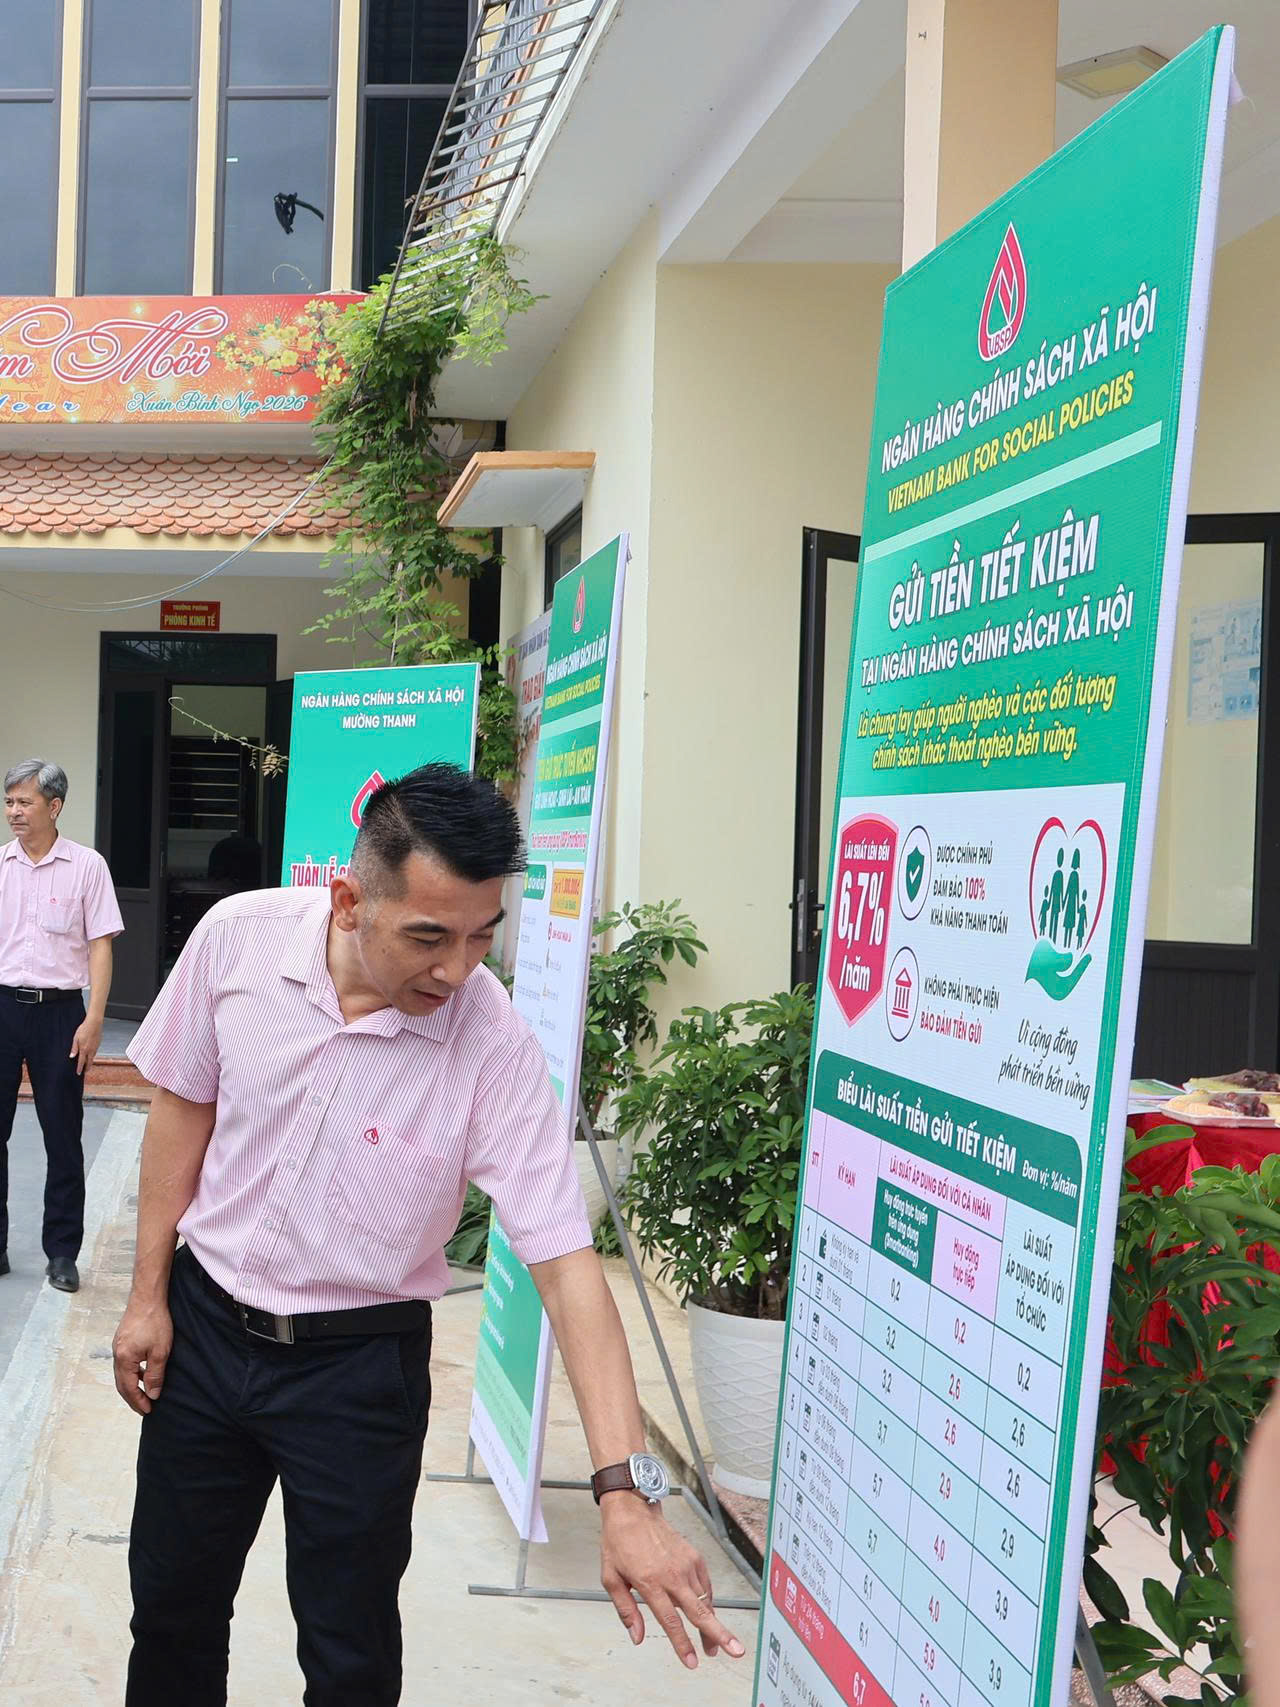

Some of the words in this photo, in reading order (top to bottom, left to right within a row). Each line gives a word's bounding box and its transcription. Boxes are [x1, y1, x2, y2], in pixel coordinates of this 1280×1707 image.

[51, 303, 229, 385] Mới
[881, 419, 921, 474] NGÂN
[922, 400, 965, 453] HÀNG
[968, 364, 1023, 429] CHÍNH
[1024, 333, 1076, 400] SÁCH
[1078, 304, 1110, 373] XÃ
[1114, 280, 1157, 354] HỘI
[176, 390, 221, 413] Bính
[261, 395, 308, 413] 2026
[888, 468, 934, 514] VIETNAM
[936, 452, 971, 494] BANK
[972, 437, 998, 476] FOR
[1001, 409, 1055, 463] SOCIAL
[1059, 370, 1134, 436] POLICIES
[888, 560, 924, 630] GỬI
[929, 538, 975, 619] TIỀN
[980, 519, 1027, 604] TIẾT
[1030, 507, 1100, 598] KIỆM
[862, 656, 879, 695] TẠI
[880, 641, 917, 684] NGÂN
[918, 633, 959, 675] HÀNG
[961, 619, 1010, 666] CHÍNH
[1013, 607, 1061, 655] SÁCH
[1063, 590, 1091, 643] XÃ
[1095, 583, 1134, 643] HỘI
[301, 693, 330, 708] NGÂN
[331, 691, 360, 708] HÀNG
[362, 688, 394, 706] CHÍNH
[396, 688, 425, 705] SÁCH
[427, 687, 442, 704] XÃ
[445, 685, 465, 708] HỘI
[869, 707, 896, 741] chung
[897, 704, 913, 737] tay
[913, 697, 935, 737] giúp
[936, 693, 967, 734] người
[967, 687, 1003, 731] nghèo
[1005, 683, 1021, 717] và
[1023, 679, 1048, 715] các
[1049, 668, 1074, 711] đối
[1074, 672, 1117, 714] tượng
[342, 713, 380, 730] MƯỜNG
[383, 714, 416, 729] THANH
[872, 740, 897, 769] chính
[897, 738, 920, 768] sách
[920, 734, 947, 766] khác
[976, 725, 1013, 768] nghèo
[1015, 716, 1040, 757] bền
[291, 854, 320, 887] TUẦN
[956, 841, 977, 865] CHÍNH
[978, 840, 994, 865] PHỦ
[965, 876, 987, 902] 100%
[837, 870, 885, 950] 6,7%
[965, 911, 987, 931] THANH
[988, 909, 1009, 935] TOÁN
[838, 953, 872, 993] /năm
[924, 973, 947, 998] KHÔNG
[947, 977, 964, 1002] PHẢI
[964, 985, 982, 1011] THỰC
[983, 985, 1000, 1014] HIỆN
[920, 1005, 935, 1032] BẢO
[953, 1011, 968, 1041] TIỀN
[968, 1017, 982, 1045] GỬI
[1029, 1024, 1052, 1059] cộng
[1052, 1025, 1079, 1066] đồng
[998, 1053, 1023, 1085] phát
[1022, 1058, 1044, 1089] triển
[1045, 1064, 1064, 1096] bền
[1064, 1072, 1091, 1111] vững
[837, 1071, 857, 1107] BIỂU
[859, 1085, 875, 1115] LÃI
[876, 1090, 903, 1126] SUẤT
[905, 1097, 929, 1137] TIỀN
[930, 1111, 954, 1149] GỬI
[956, 1119, 981, 1159] TIẾT
[982, 1134, 1017, 1176] KIỆM
[1022, 1159, 1039, 1182] Đơn
[953, 1237, 965, 1261] Huy
[1024, 1228, 1034, 1253] LÃI
[1035, 1234, 1053, 1262] SUẤT
[1005, 1253, 1016, 1278] ÁP
[1015, 1262, 1036, 1290] DỤNG
[1036, 1270, 1051, 1298] ĐỐI
[1052, 1280, 1065, 1306] VỚI
[1016, 1290, 1026, 1320] TỔ
[1026, 1305, 1047, 1332] CHỨC
[954, 1317, 966, 1346] 0,2
[1017, 1362, 1031, 1392] 0,2
[1012, 1417, 1026, 1448] 2,6
[1007, 1468, 1020, 1499] 2,6
[1001, 1528, 1015, 1559] 2,9
[995, 1590, 1009, 1621] 3,9
[853, 1672, 867, 1706] 6,7
[989, 1658, 1003, 1691] 3,9
